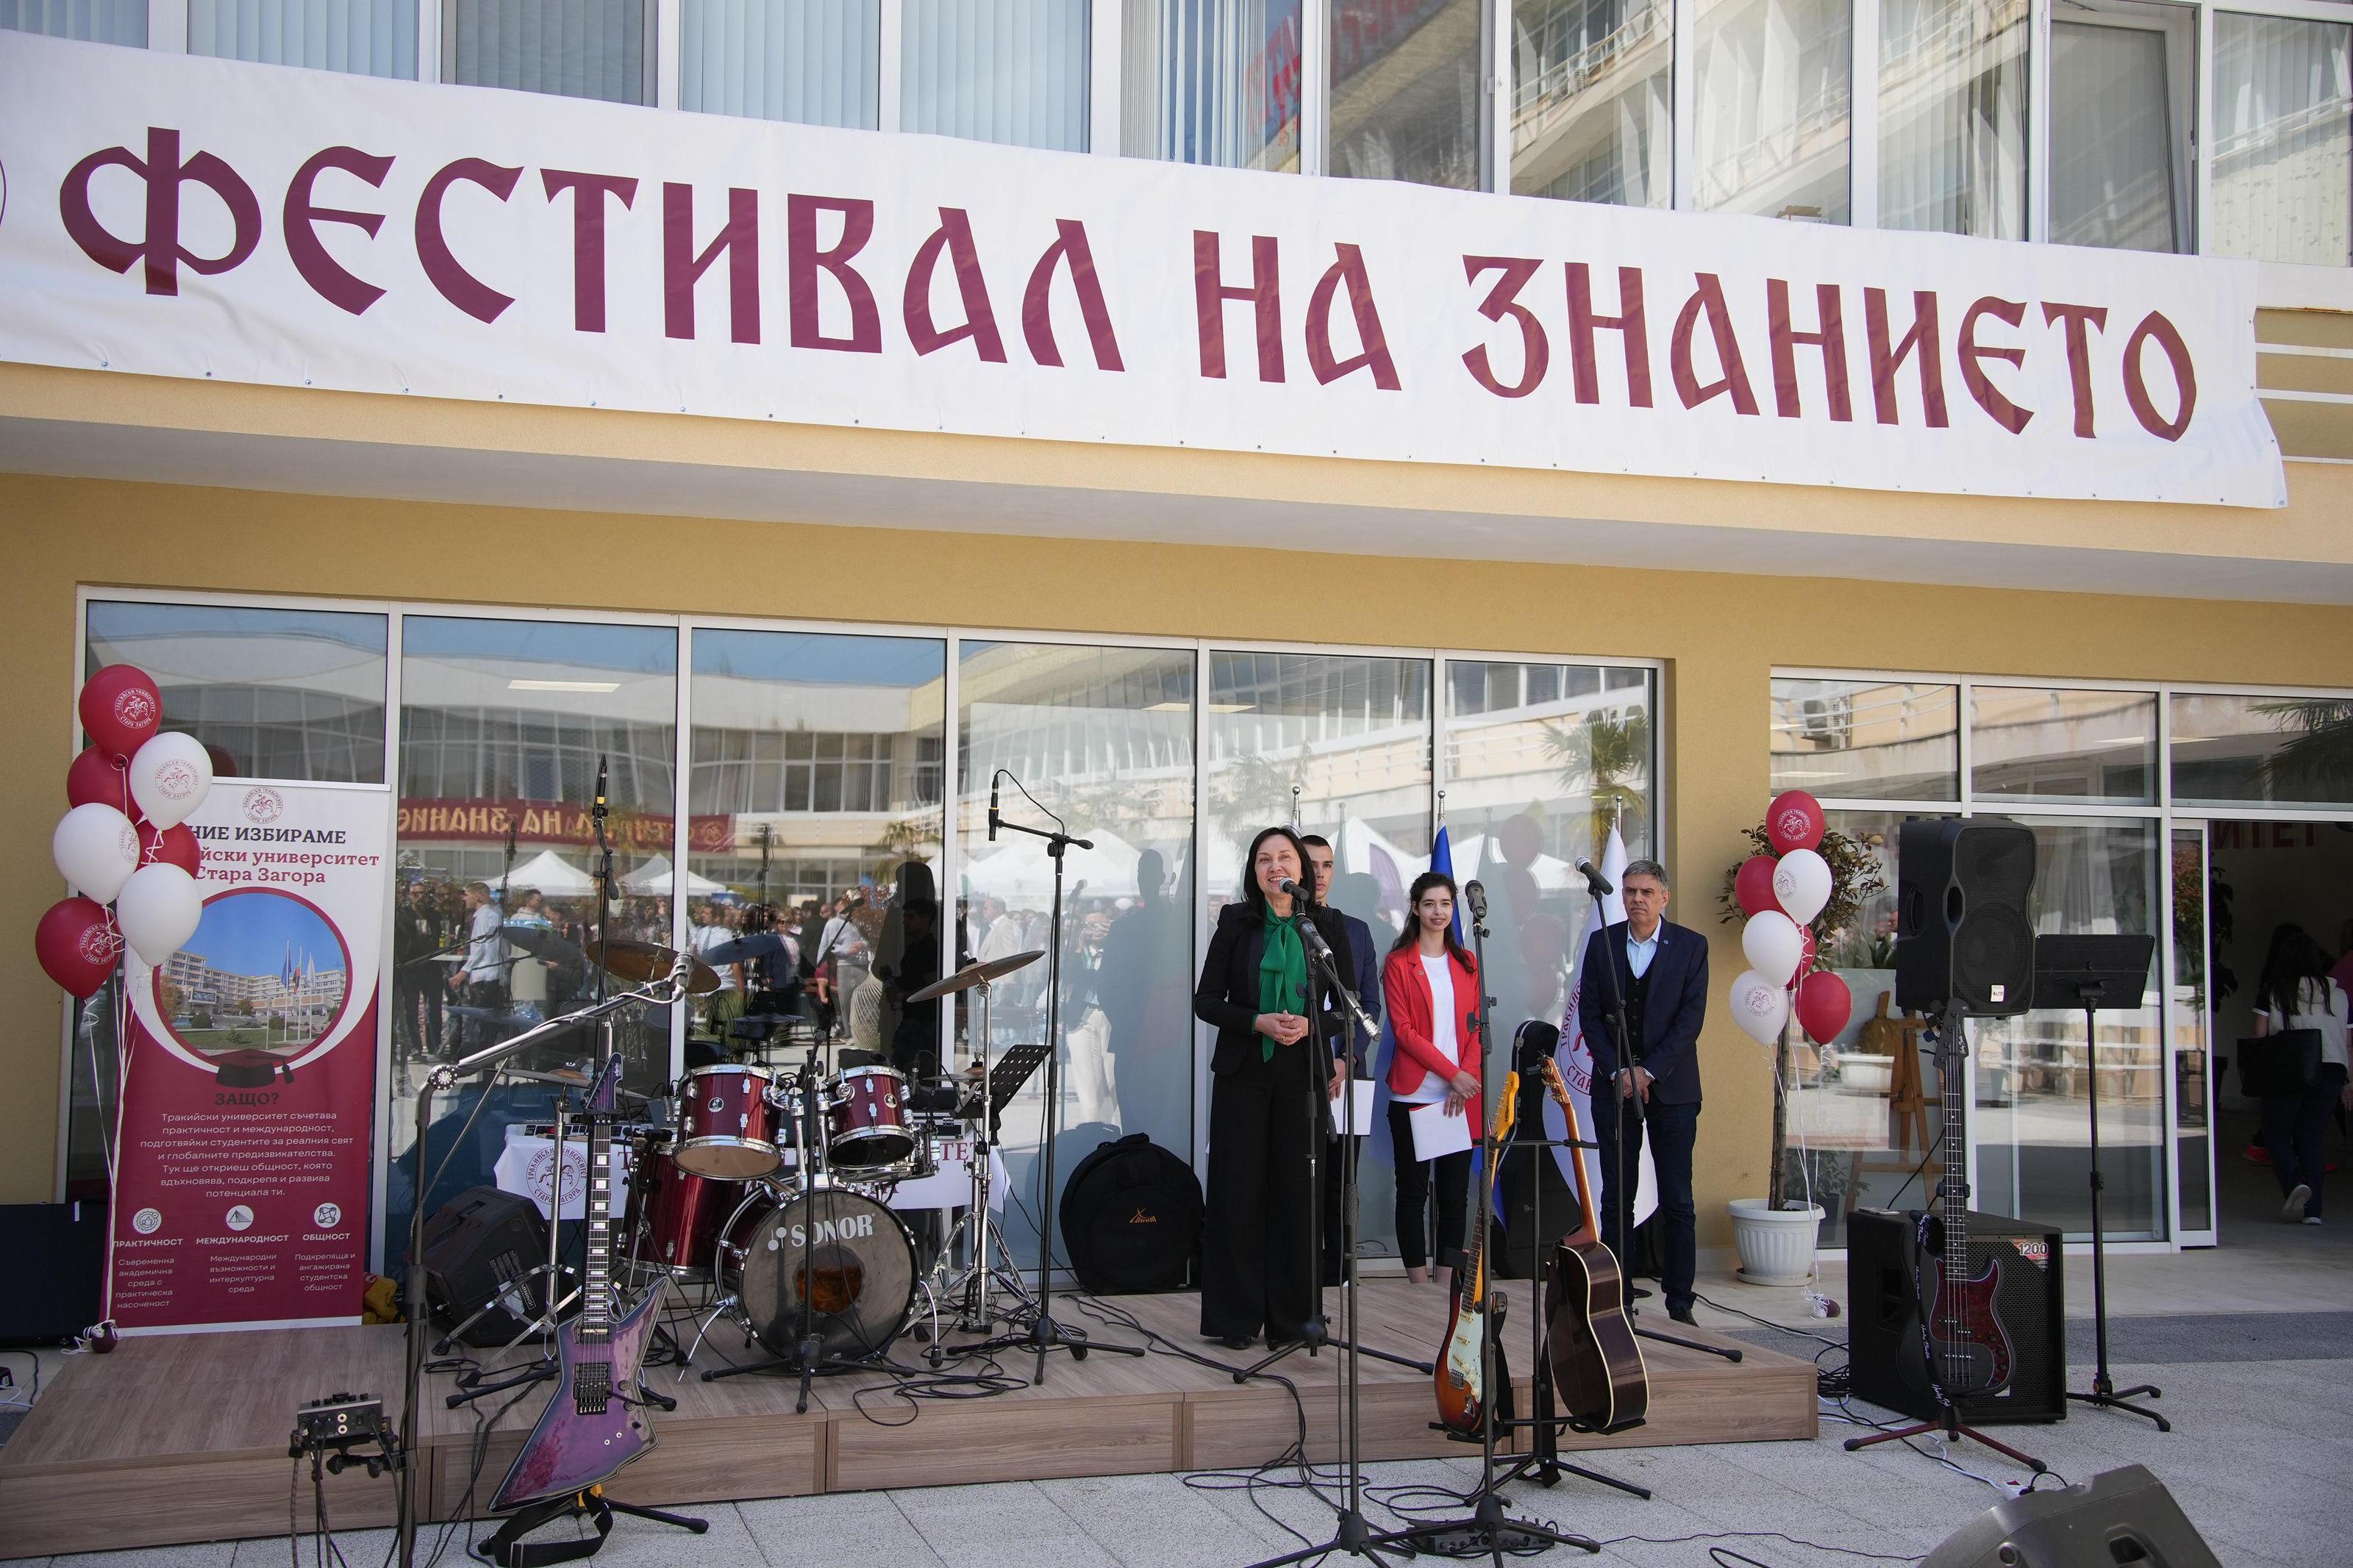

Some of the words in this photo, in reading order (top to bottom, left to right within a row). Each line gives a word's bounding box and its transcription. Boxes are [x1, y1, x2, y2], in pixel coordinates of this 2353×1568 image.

[60, 126, 1125, 372] ФЕСТИВАЛ
[1193, 229, 1402, 391] НА
[1461, 254, 2196, 443] ЗНАНИЕТО
[235, 827, 346, 844] ИЗБИРАМЕ
[252, 851, 379, 867] университет
[258, 867, 325, 887] Загора
[1560, 985, 1581, 1050] ТРАКИЙС
[1567, 1065, 1592, 1090] СТАР
[214, 1092, 279, 1106] ЗАЩО?
[161, 1113, 219, 1123] Тракийски
[221, 1112, 288, 1123] университет
[290, 1111, 337, 1120] съчетава
[163, 1126, 230, 1136] практичност
[243, 1125, 335, 1134] международност,
[140, 1138, 207, 1148] подготвяйки
[210, 1138, 270, 1147] студентите
[286, 1137, 329, 1147] реалния
[168, 1150, 229, 1161] глобалните
[232, 1150, 335, 1160] предизвикателства.
[163, 1164, 181, 1174] Тук
[183, 1165, 200, 1173] ще
[201, 1164, 249, 1174] откриеш
[251, 1162, 301, 1172] общност,
[563, 1148, 587, 1178] ИВЕРСИТЕТ
[161, 1176, 224, 1186] вдъхновява,
[227, 1175, 277, 1185] подкрепя
[289, 1175, 330, 1184] развива
[206, 1189, 268, 1198] потенциала
[560, 1188, 581, 1203] АГОРА
[790, 1214, 874, 1247] SONOR
[113, 1238, 183, 1247] ПРАКТИЧНОСТ
[196, 1234, 290, 1245] МЕЖДУНАРОДНОСТ
[303, 1233, 351, 1242] ОБЩНОСТ
[2018, 1242, 2048, 1256] 1200
[118, 1258, 175, 1267] Съвременна
[210, 1253, 277, 1262] Международни
[295, 1253, 349, 1261] Подкрепяща
[210, 1264, 268, 1272] възможности
[299, 1263, 350, 1271] ангажирана
[119, 1269, 173, 1277] академична
[300, 1273, 348, 1282] студентска
[128, 1280, 155, 1288] среда
[210, 1275, 275, 1284] интеркултурна
[228, 1286, 254, 1294] среда
[304, 1284, 343, 1292] общност
[115, 1289, 173, 1299] практическа
[118, 1300, 170, 1309] насоченост
